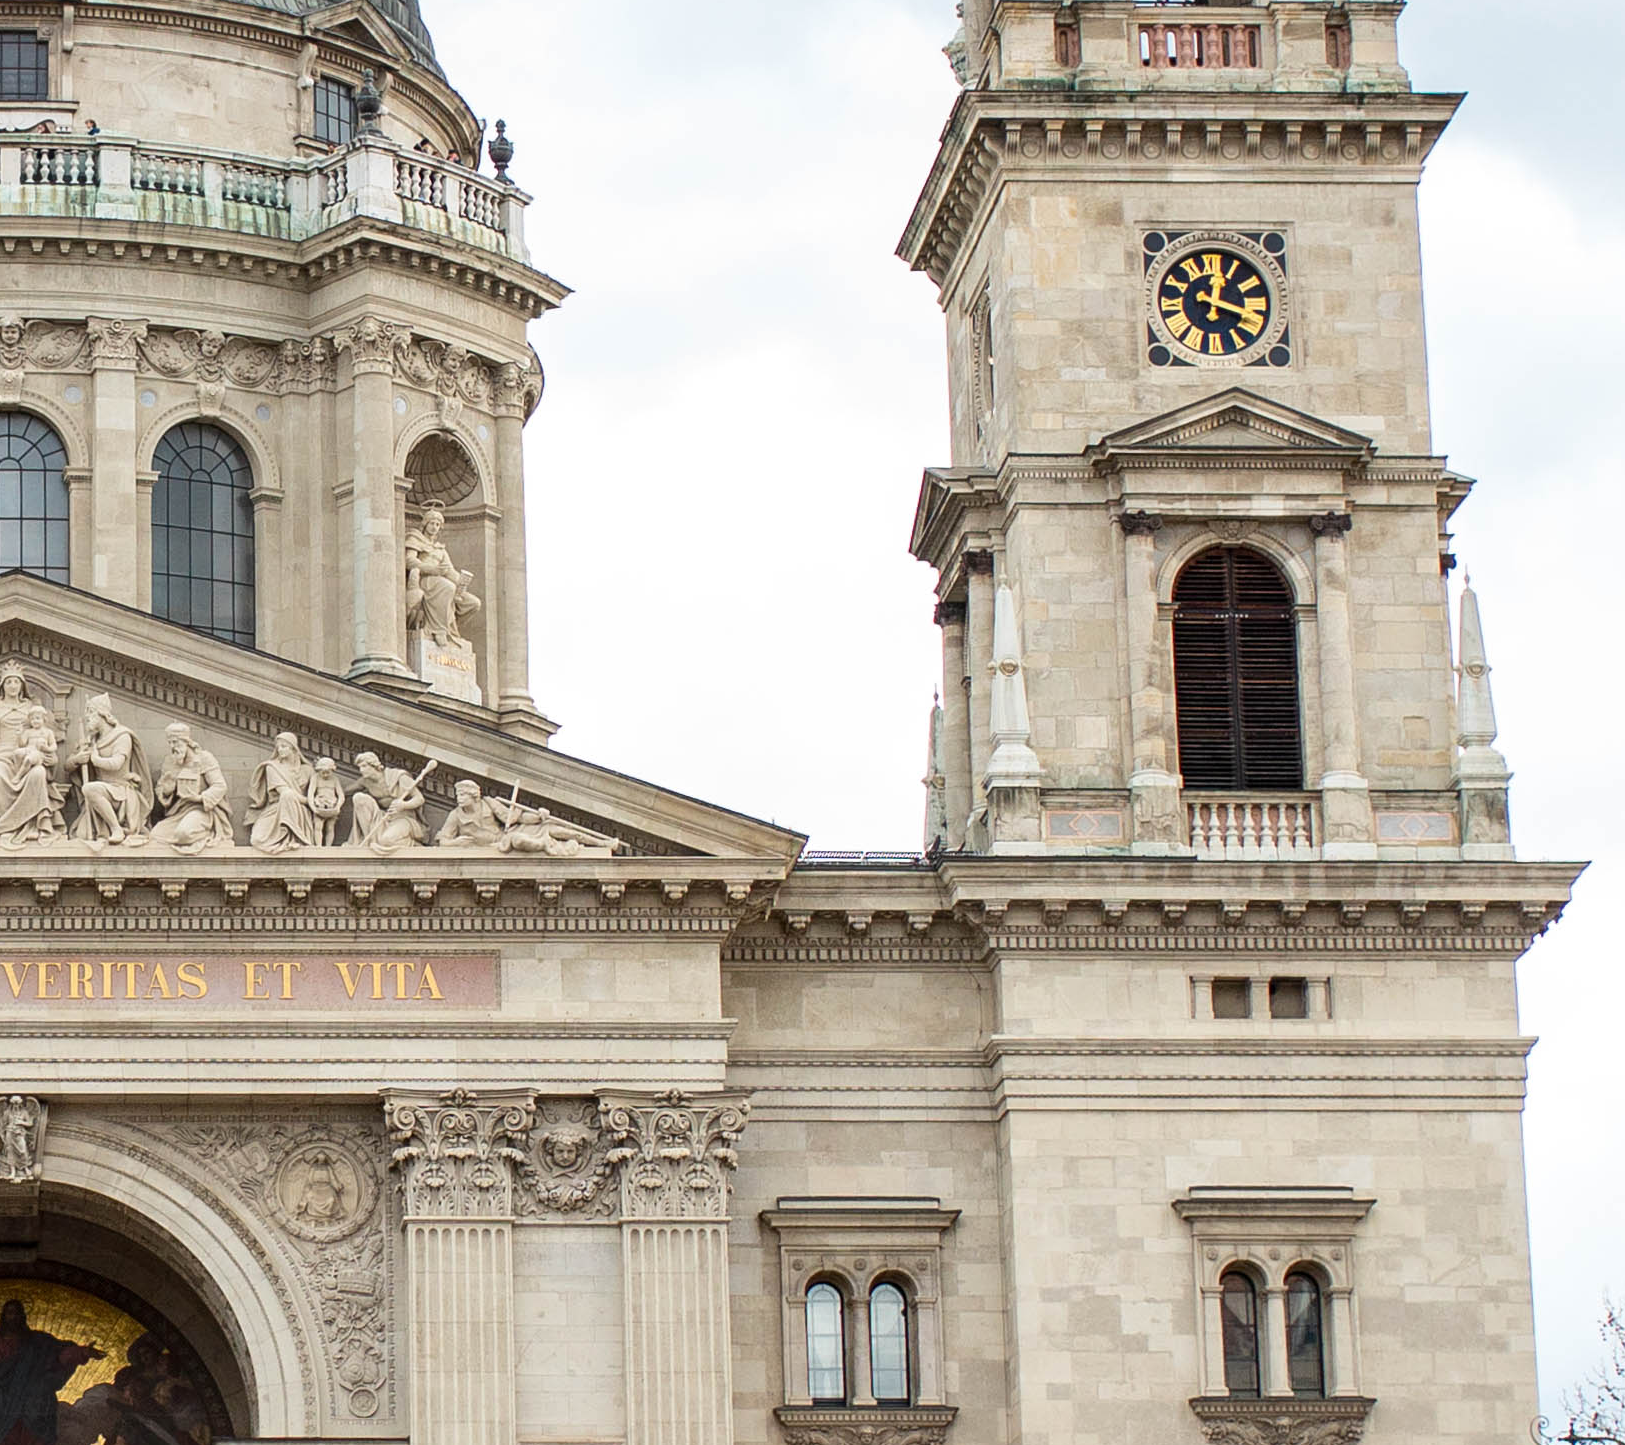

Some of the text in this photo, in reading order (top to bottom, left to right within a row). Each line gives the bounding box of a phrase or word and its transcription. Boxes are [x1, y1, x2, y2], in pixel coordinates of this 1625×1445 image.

[0, 961, 208, 999] VERITAS
[242, 962, 301, 999] ET
[334, 962, 445, 1000] VITA
